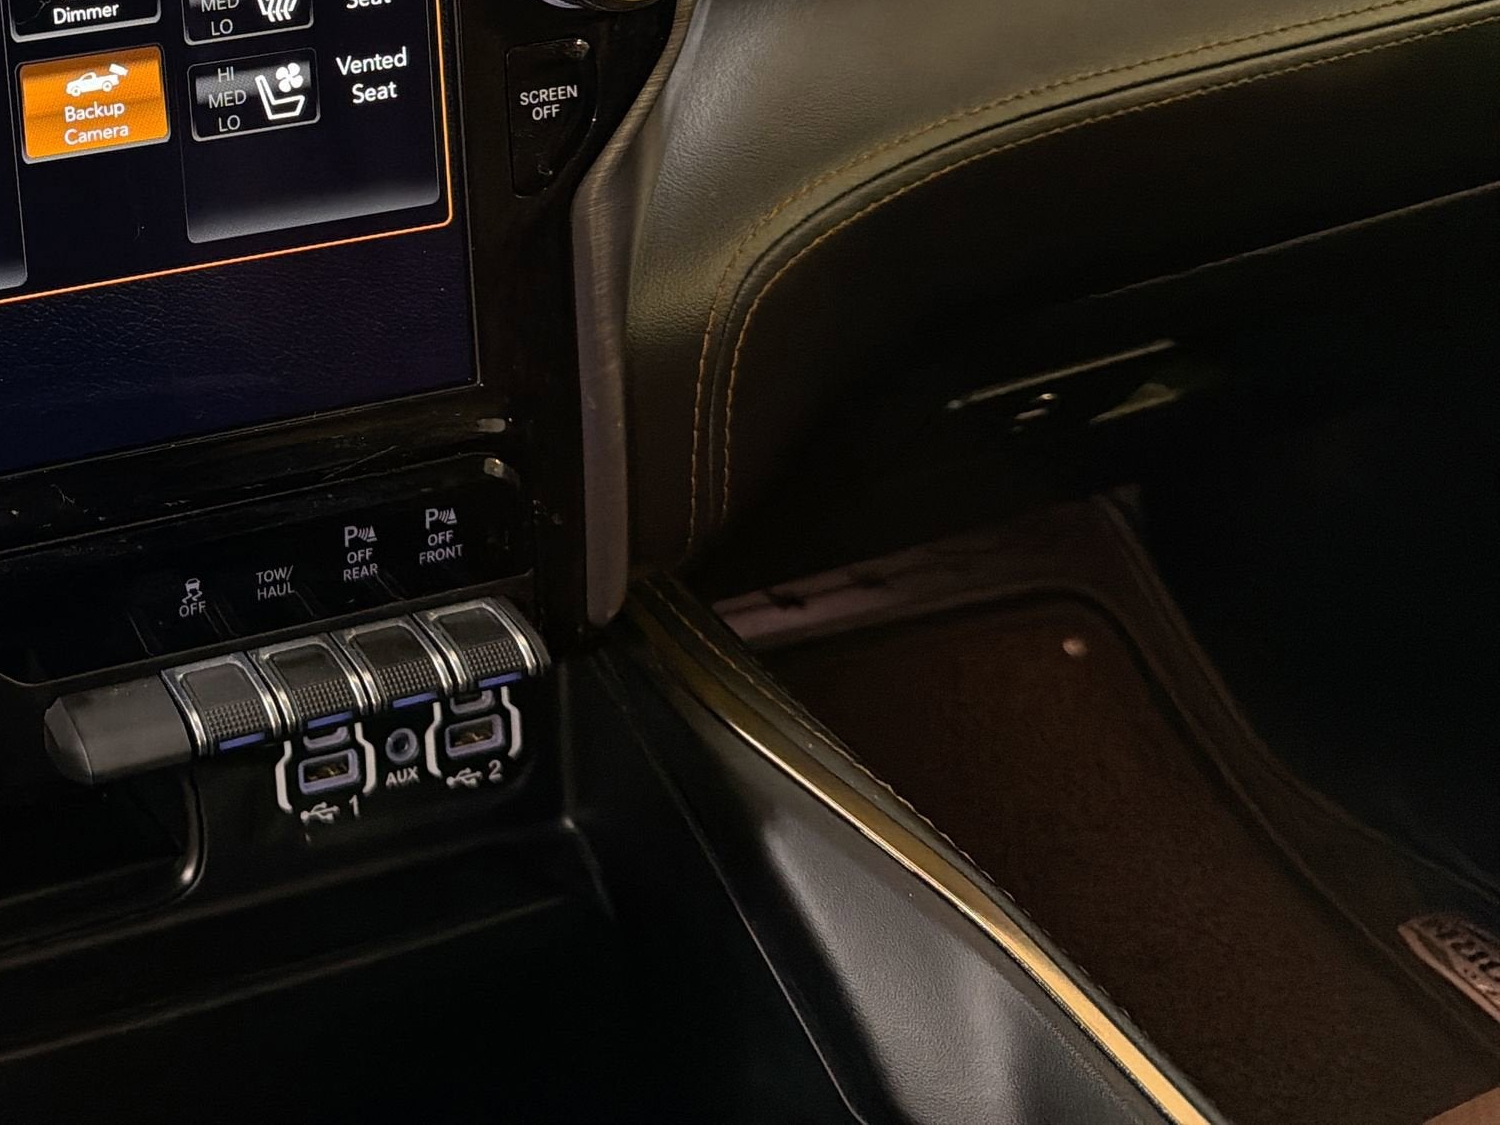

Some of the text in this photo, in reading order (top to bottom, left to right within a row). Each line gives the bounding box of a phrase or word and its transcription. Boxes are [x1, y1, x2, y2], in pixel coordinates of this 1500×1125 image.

[52, 1, 119, 24] Dimmer
[210, 19, 234, 36] LO
[336, 48, 408, 77] Vented
[218, 67, 236, 83] HI
[209, 88, 247, 109] MED
[352, 79, 398, 104] Seat
[519, 84, 578, 107] SCREEN
[64, 100, 125, 125] Backup
[218, 114, 241, 132] LO
[531, 103, 560, 122] OFF
[64, 122, 129, 145] Camera
[427, 531, 454, 547] OFF
[347, 547, 374, 563] OFF
[418, 543, 463, 564] FRONT
[256, 565, 295, 583] TOW/
[343, 564, 379, 583] REAR
[257, 581, 295, 599] HAUL
[179, 600, 207, 618] OFF
[385, 766, 420, 787] AUX
[487, 759, 501, 782] 2
[349, 796, 360, 819] 1
